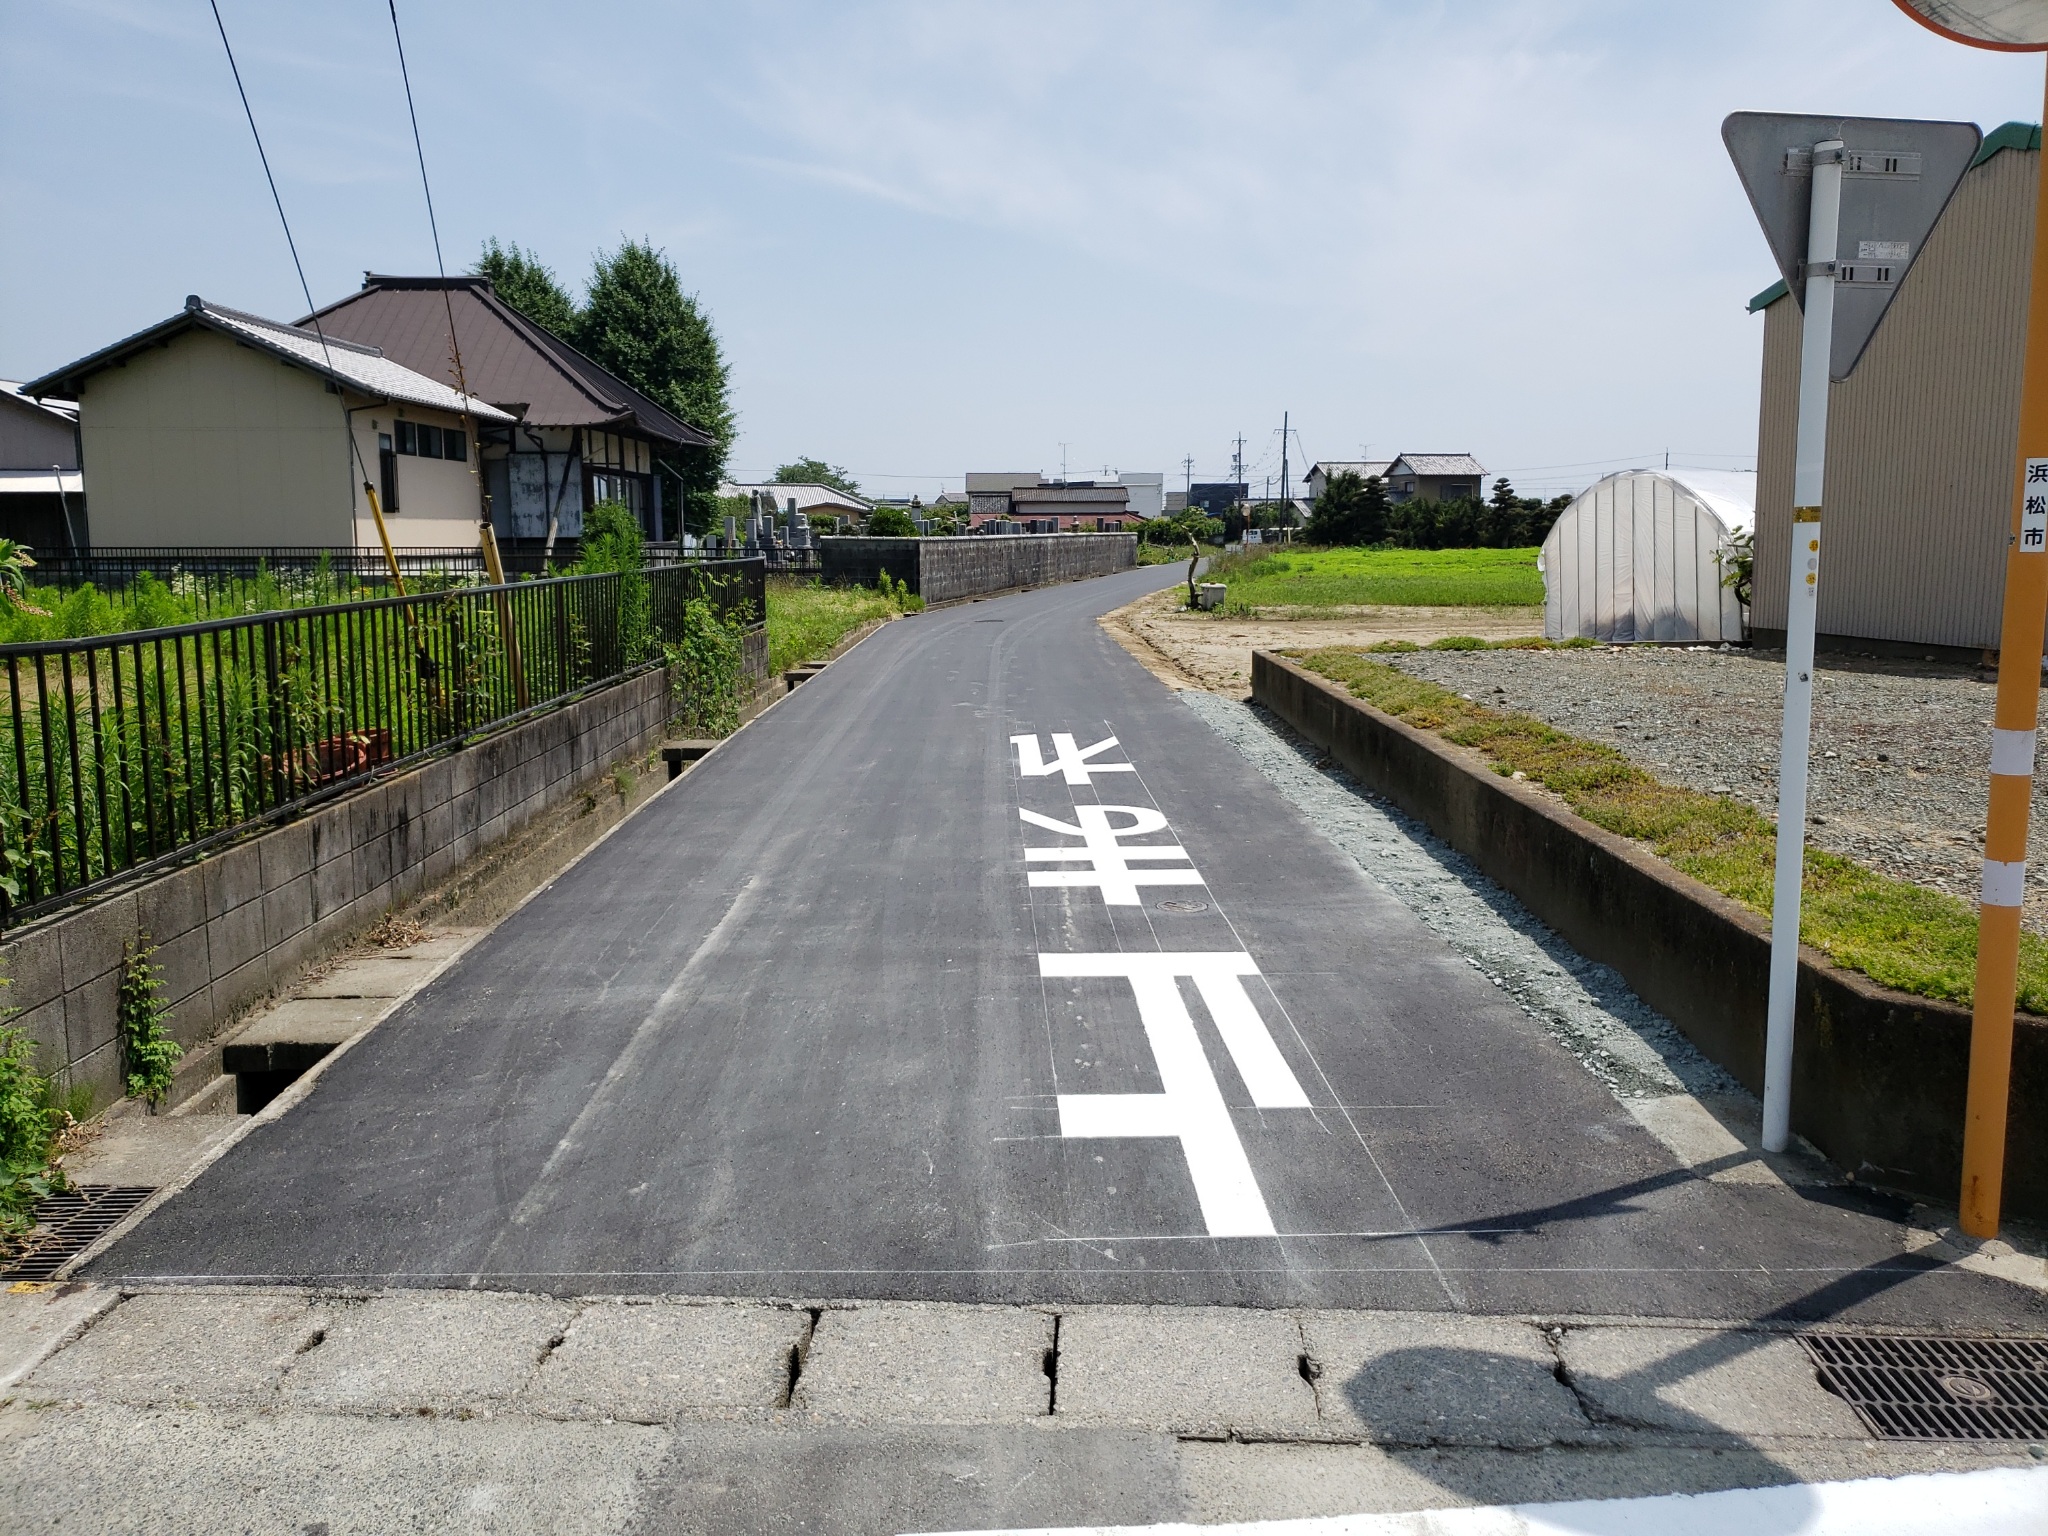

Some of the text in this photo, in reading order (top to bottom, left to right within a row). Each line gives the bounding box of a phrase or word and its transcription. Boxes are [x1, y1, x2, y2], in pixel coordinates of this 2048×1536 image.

[2024, 464, 2048, 546] 浜松市
[1010, 733, 1312, 1237] 止まれ
